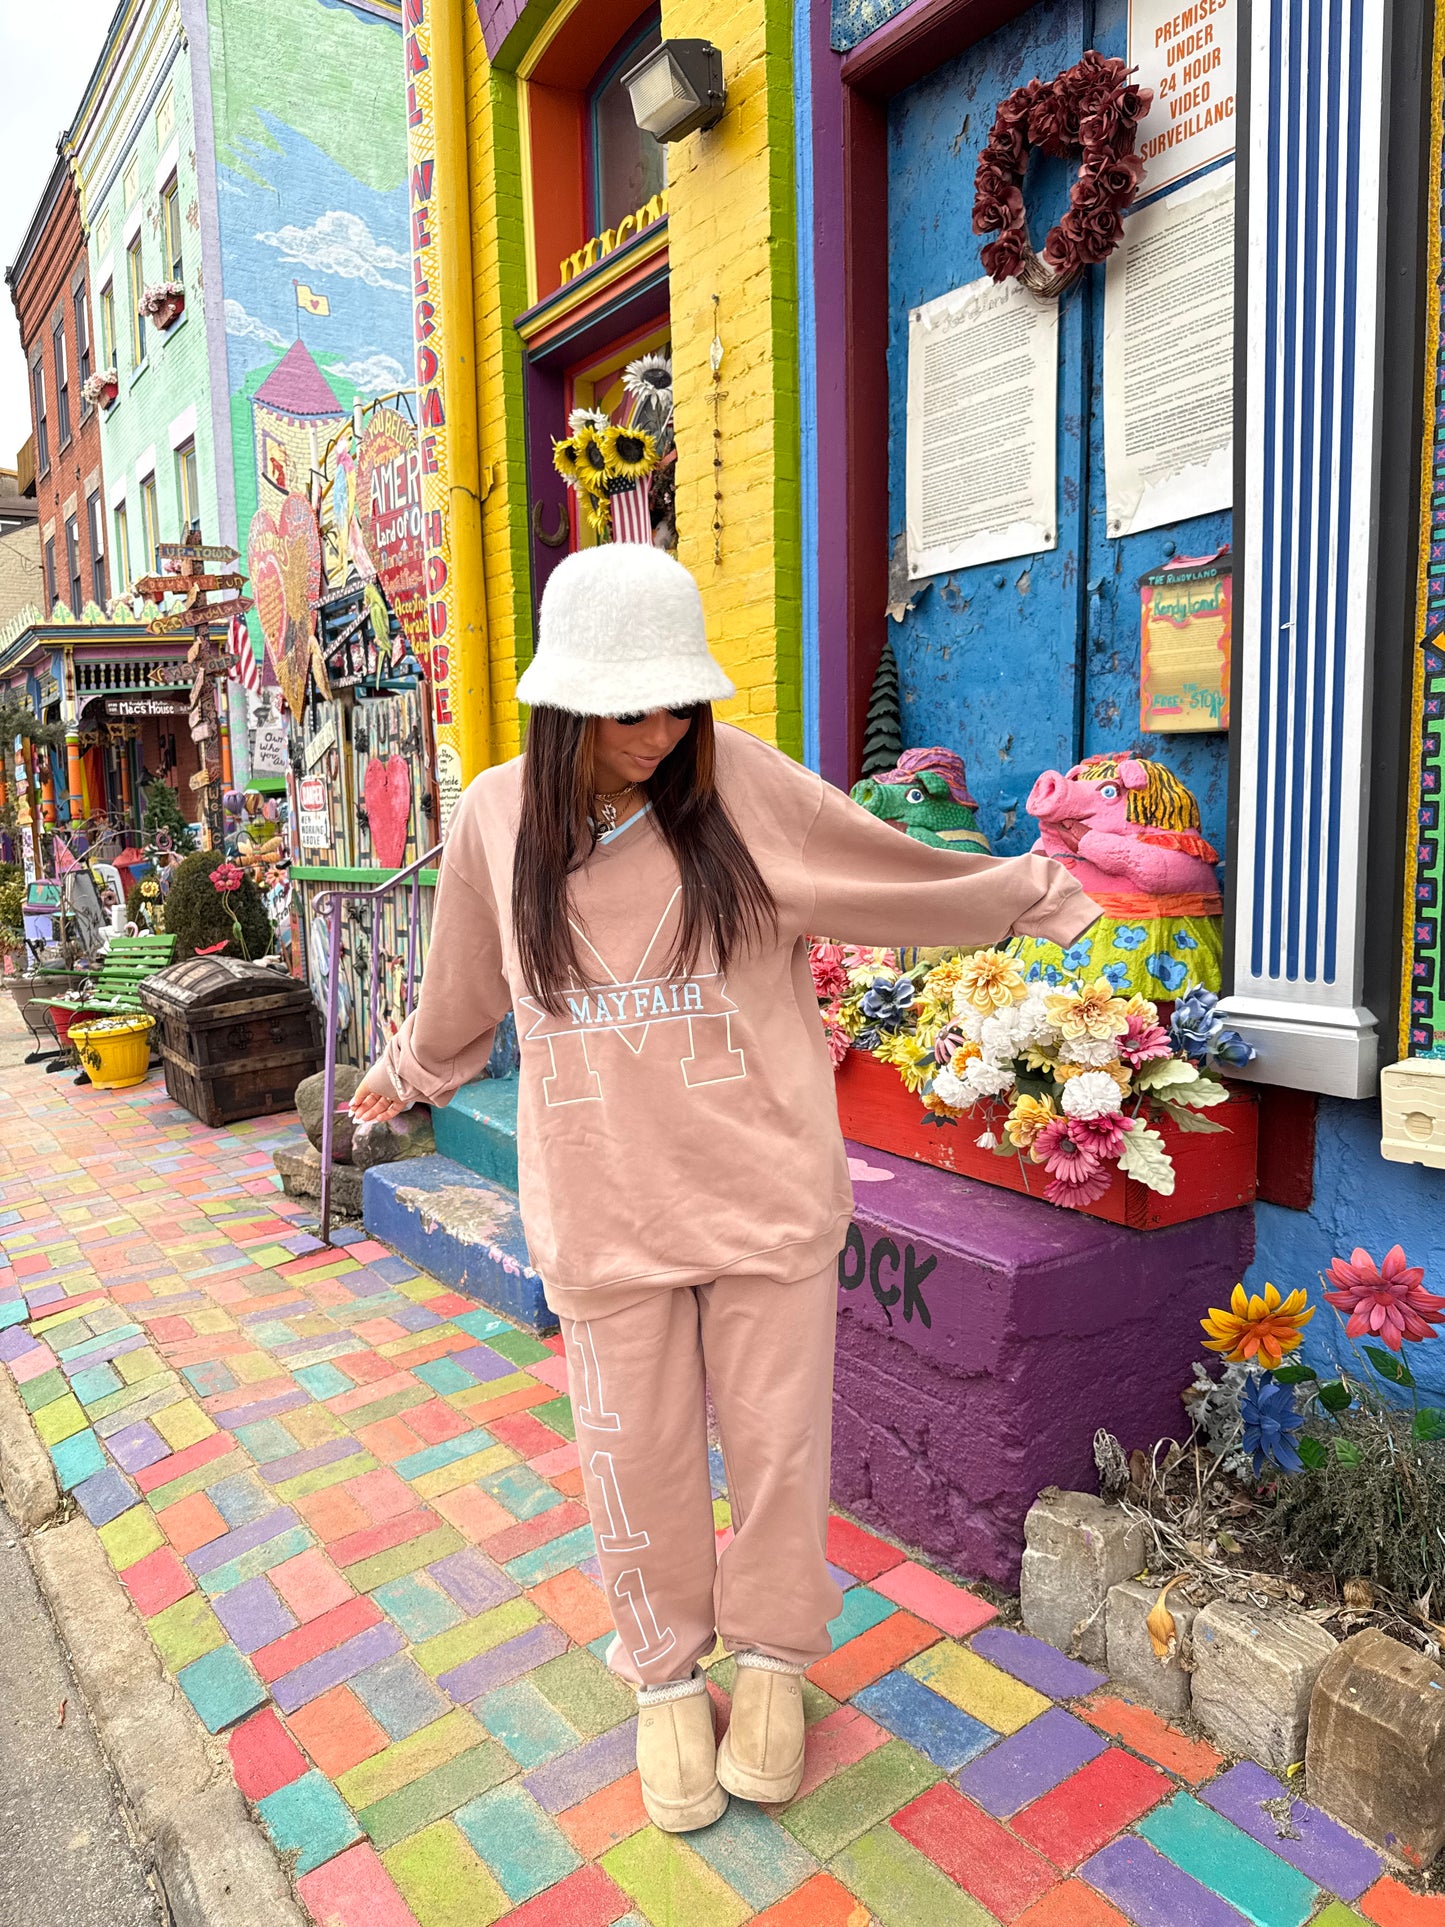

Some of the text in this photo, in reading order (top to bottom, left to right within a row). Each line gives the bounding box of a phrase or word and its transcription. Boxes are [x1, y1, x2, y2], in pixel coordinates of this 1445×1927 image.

[1167, 24, 1213, 67] UNDER
[1160, 47, 1221, 99] 24 HOUR
[1170, 81, 1210, 120] VIDEO
[1140, 95, 1236, 164] SURVEILLANC
[409, 159, 445, 474] WELCOME
[376, 517, 396, 548] Land
[1149, 568, 1217, 585] THE RANDYLAND
[424, 509, 452, 725] HOUSE
[567, 982, 704, 1026] MAYFAIR
